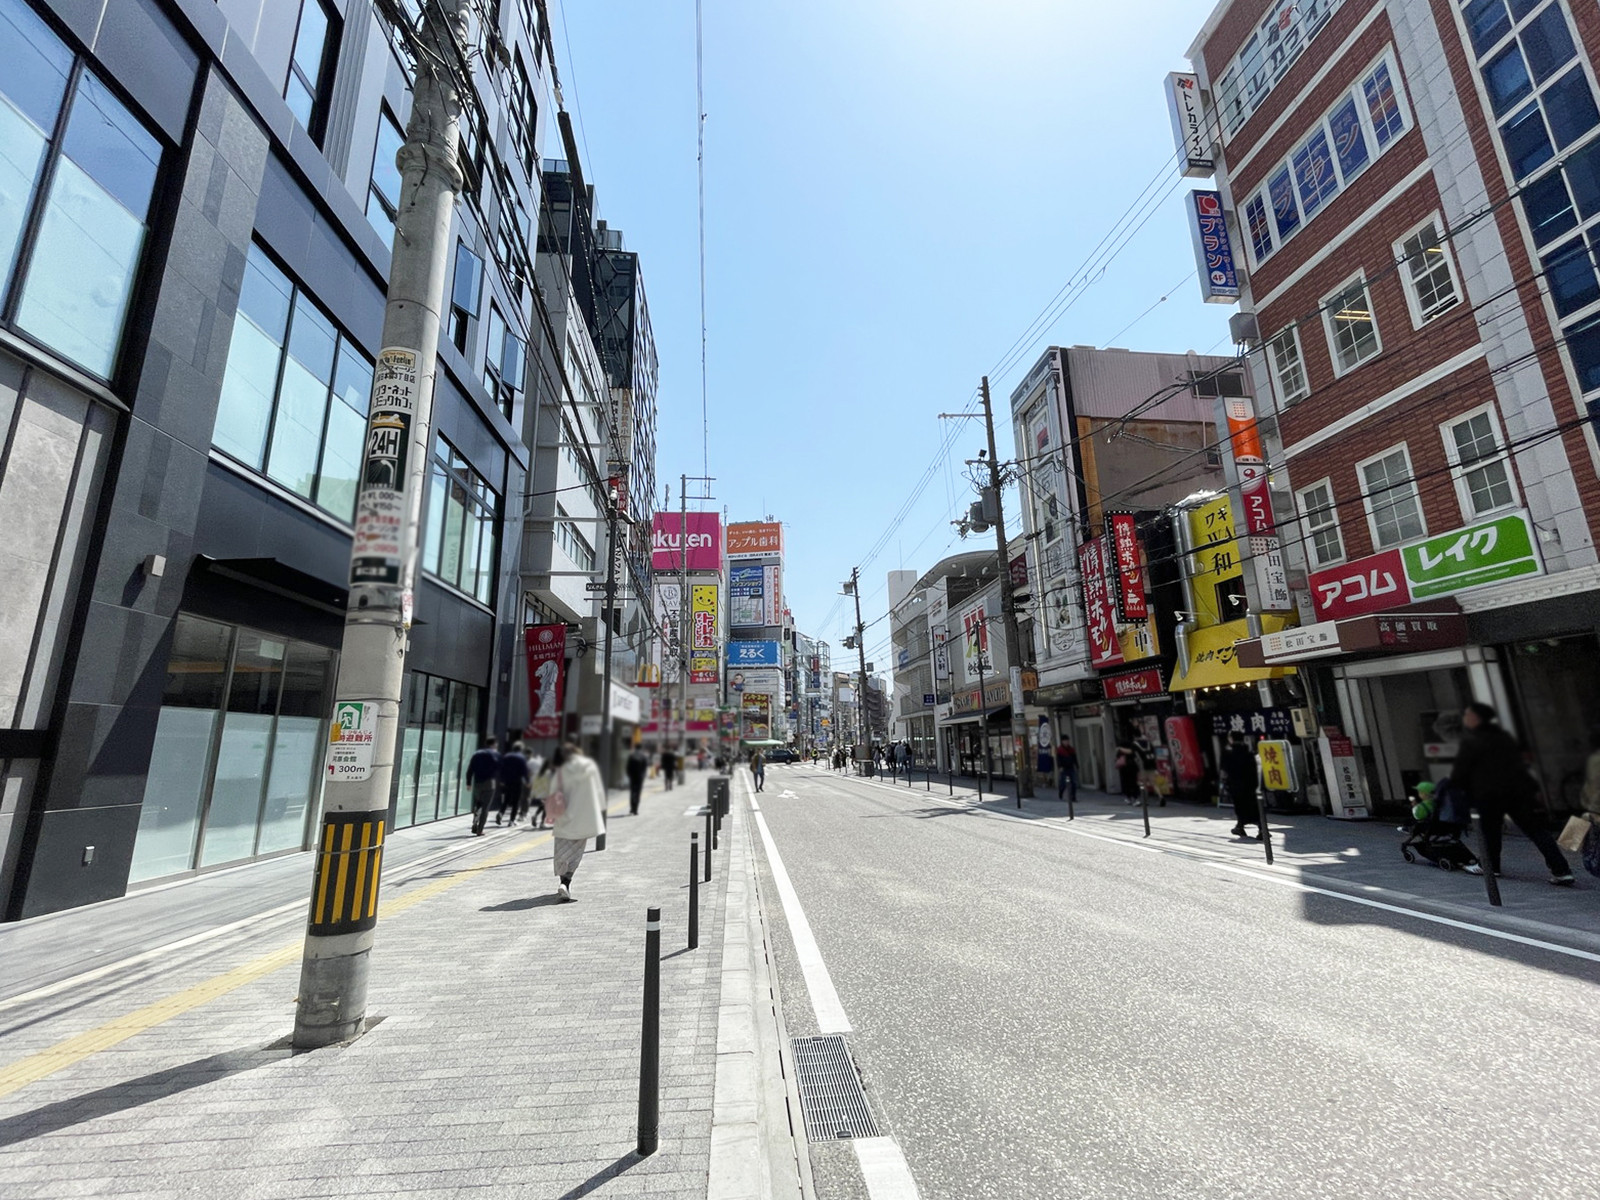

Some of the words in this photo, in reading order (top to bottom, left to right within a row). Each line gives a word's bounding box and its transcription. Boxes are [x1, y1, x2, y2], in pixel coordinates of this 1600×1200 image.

[1183, 91, 1203, 157] トレカライン
[1200, 218, 1222, 268] プラン
[371, 430, 399, 455] 24H
[1250, 495, 1269, 533] アコム
[728, 536, 778, 548] アップル歯科
[1418, 526, 1498, 571] レイク
[1212, 552, 1232, 576] 和
[1318, 569, 1397, 609] アコム
[740, 648, 765, 658] えるく
[1230, 712, 1266, 734] 焼肉
[1264, 746, 1283, 786] 焼肉
